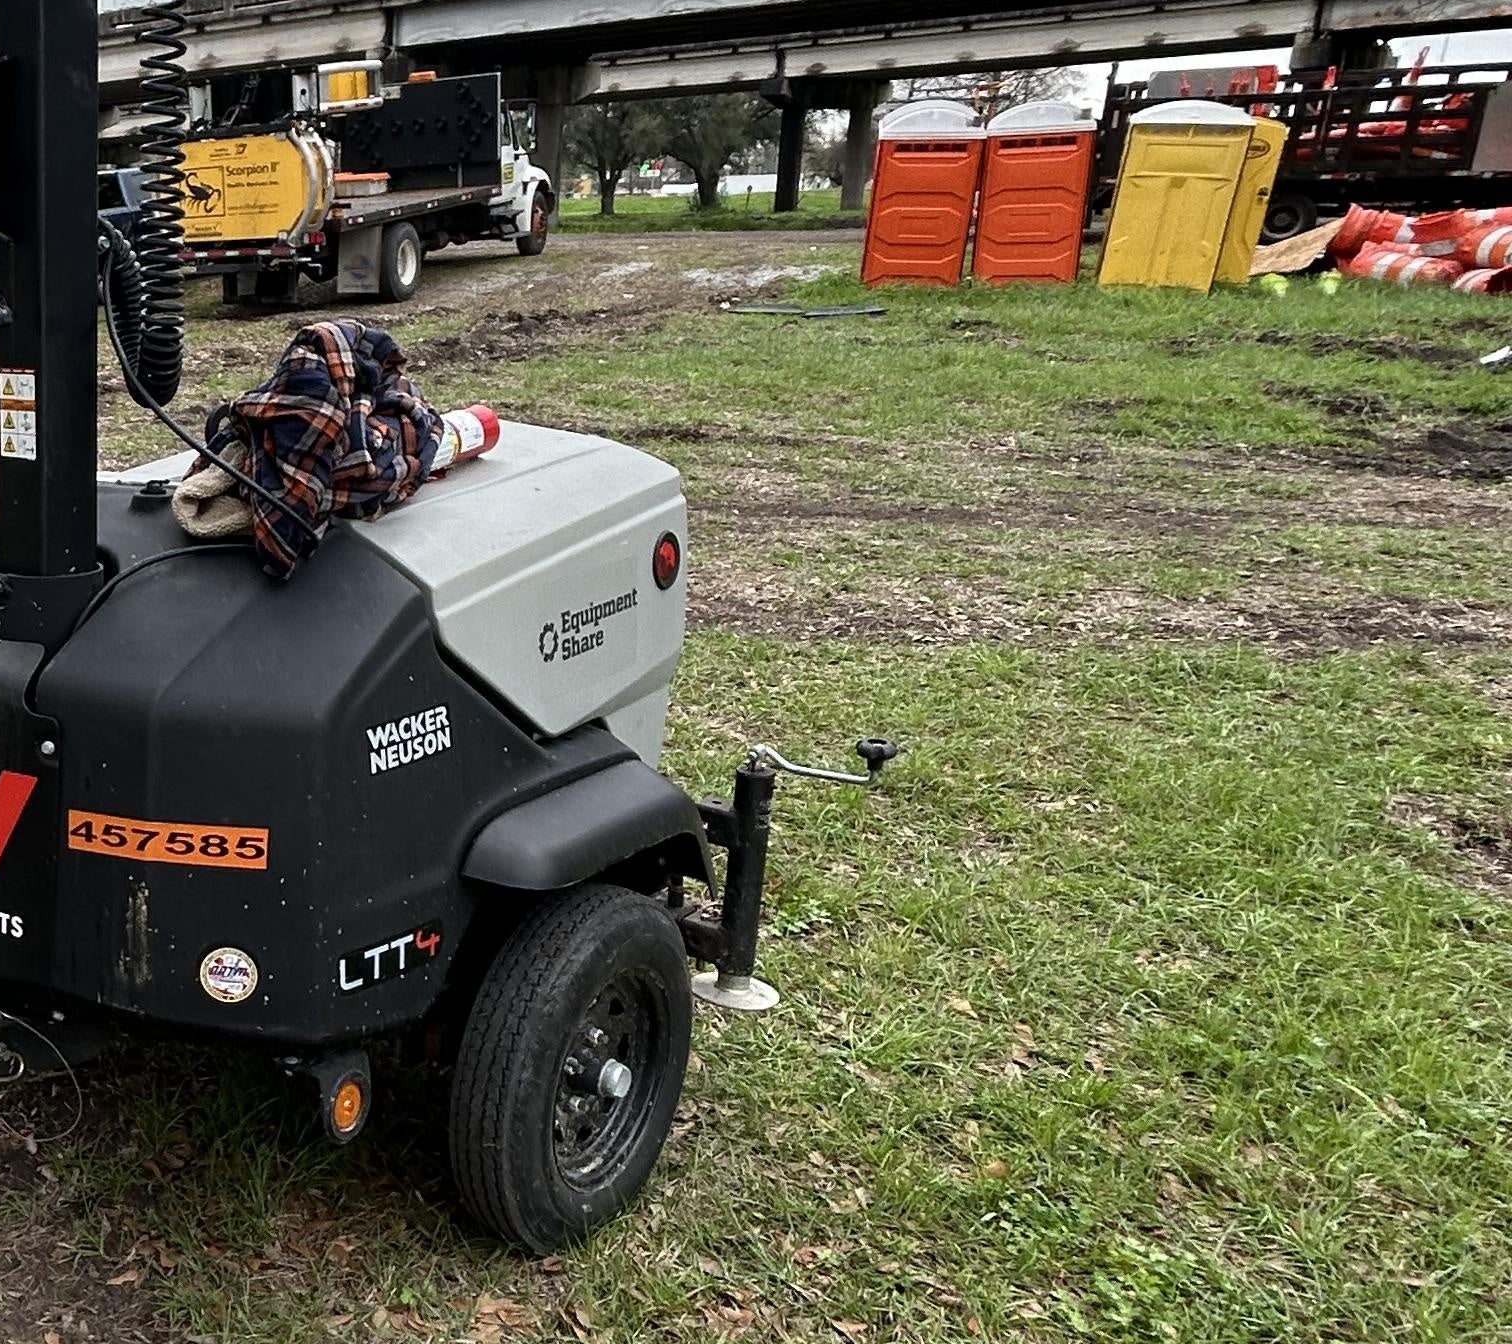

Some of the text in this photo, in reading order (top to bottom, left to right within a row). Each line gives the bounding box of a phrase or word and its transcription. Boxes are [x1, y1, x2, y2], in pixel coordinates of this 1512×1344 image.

[225, 164, 269, 177] Scorpion
[560, 587, 638, 634] Equipment
[561, 629, 604, 661] Share
[366, 706, 450, 750] WACKER
[369, 726, 452, 775] NEUSON
[69, 820, 266, 860] 457585
[339, 929, 441, 991] LTT4
